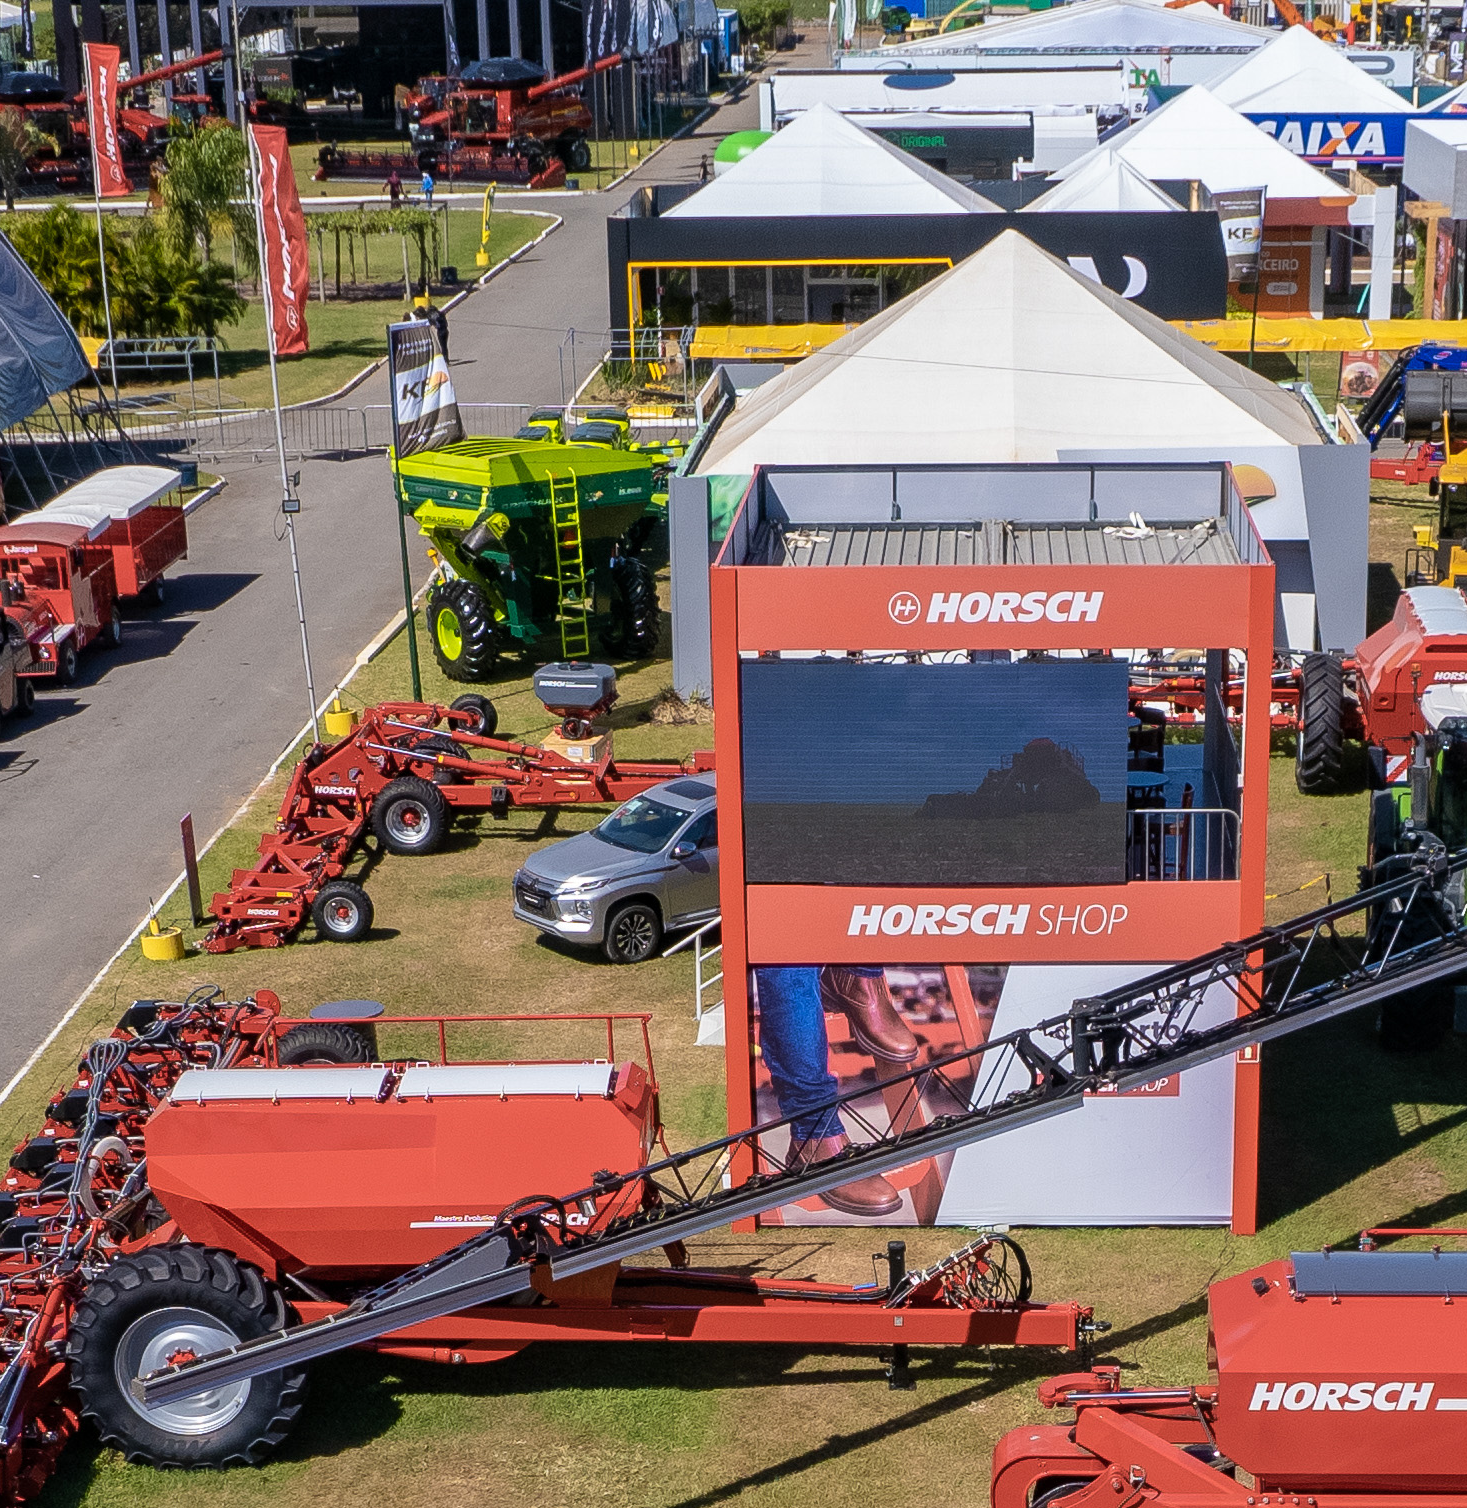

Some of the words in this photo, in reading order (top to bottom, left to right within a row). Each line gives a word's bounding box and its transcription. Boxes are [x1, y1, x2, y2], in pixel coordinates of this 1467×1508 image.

[926, 591, 1104, 623] HORSCH
[314, 785, 357, 796] HORSCH
[246, 908, 279, 917] HORSCH
[846, 904, 1031, 936] HORSCH
[1035, 904, 1129, 936] SHOP
[1248, 1381, 1436, 1412] HORSCH
